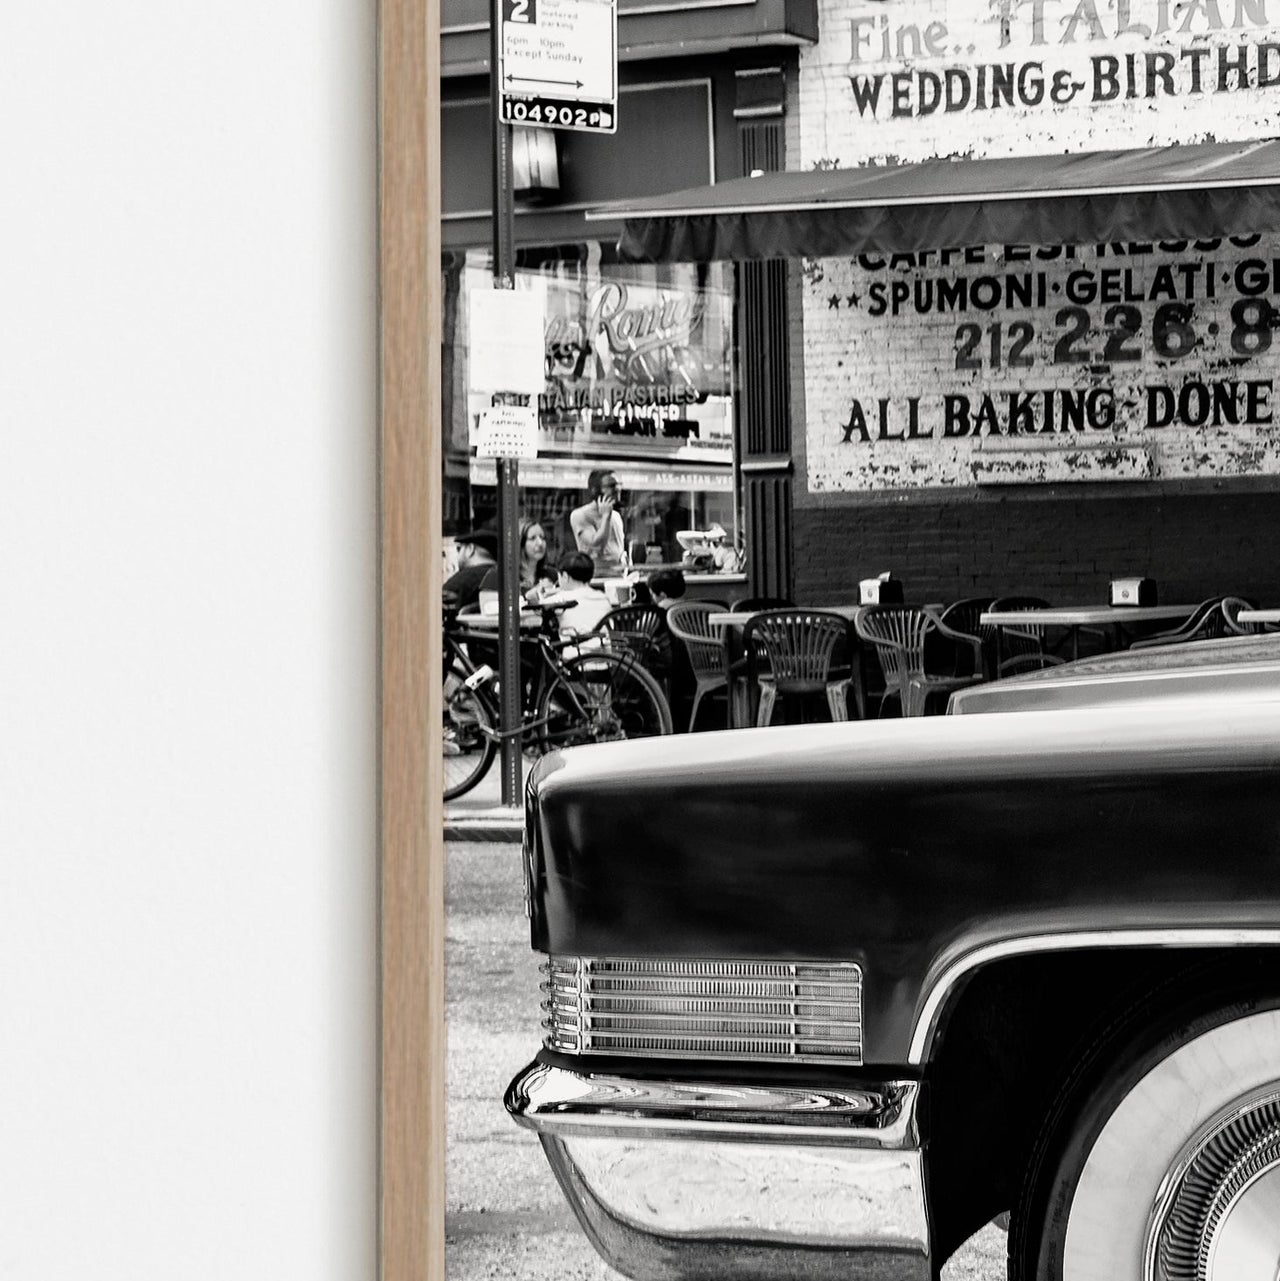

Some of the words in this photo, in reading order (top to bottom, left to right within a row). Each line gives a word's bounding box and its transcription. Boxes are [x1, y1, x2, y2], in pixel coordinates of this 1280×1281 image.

[506, 35, 529, 47] 6pm
[539, 37, 566, 49] 10pm
[541, 20, 575, 32] parking
[506, 46, 542, 61] Except
[545, 49, 584, 65] Sunday
[849, 60, 1045, 118] WEDDING
[867, 272, 1047, 317] SPUMONI
[1065, 261, 1216, 305] GELATI
[954, 322, 1035, 371] 212
[612, 383, 696, 405] PASTRIES
[841, 398, 935, 443] ALL
[942, 388, 1115, 440] BAKING
[1144, 380, 1274, 429] DONE
